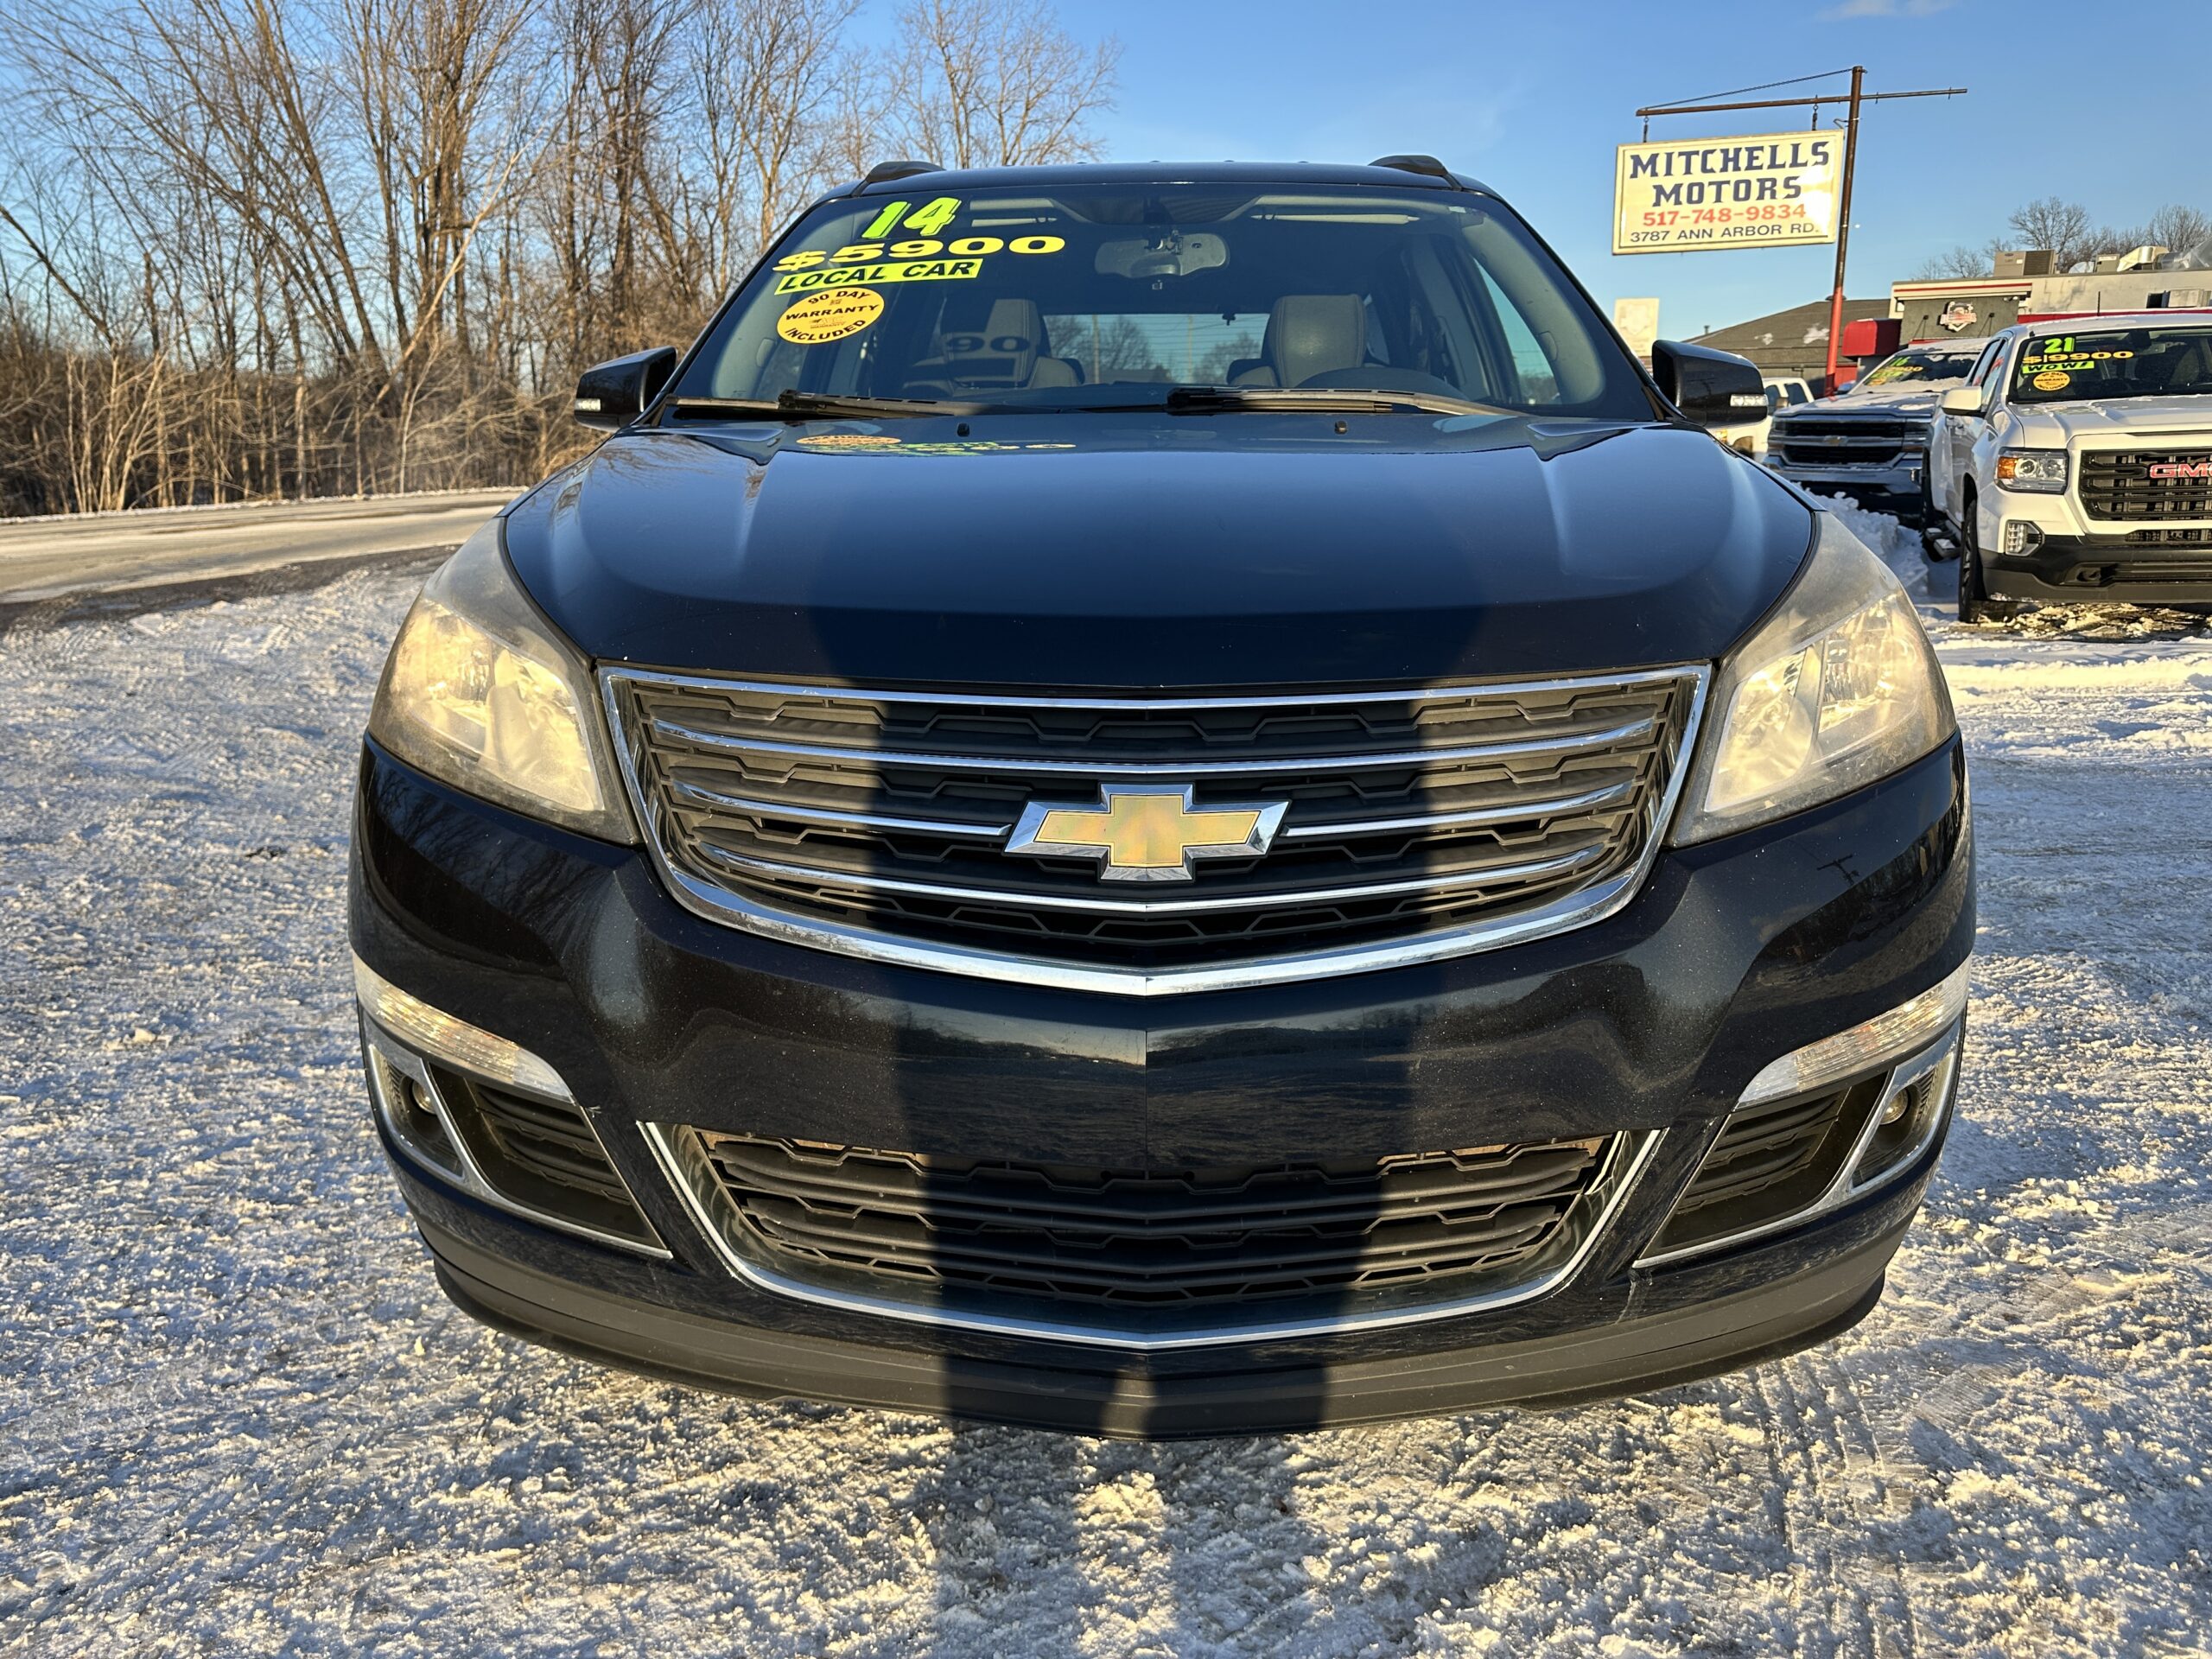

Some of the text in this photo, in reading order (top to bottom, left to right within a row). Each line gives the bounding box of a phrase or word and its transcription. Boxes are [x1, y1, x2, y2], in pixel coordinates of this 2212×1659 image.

[1630, 142, 1829, 179] MITCHELLS
[1652, 175, 1802, 207] MOTORS
[861, 197, 962, 239] 14
[1643, 204, 1806, 226] 517-748-9834
[1630, 223, 1819, 242] 3787 ANN ARBOR RD.
[772, 236, 1065, 271] $5900
[779, 261, 977, 290] LOCAL CAR
[808, 294, 830, 304] 90
[836, 290, 870, 299] DAY
[785, 304, 879, 321] WARRANTY
[785, 320, 866, 340] INCLUDED
[2044, 337, 2075, 353] 21
[2023, 351, 2133, 364] $19900
[2028, 362, 2088, 372] WOW!
[2150, 463, 2212, 479] GM
